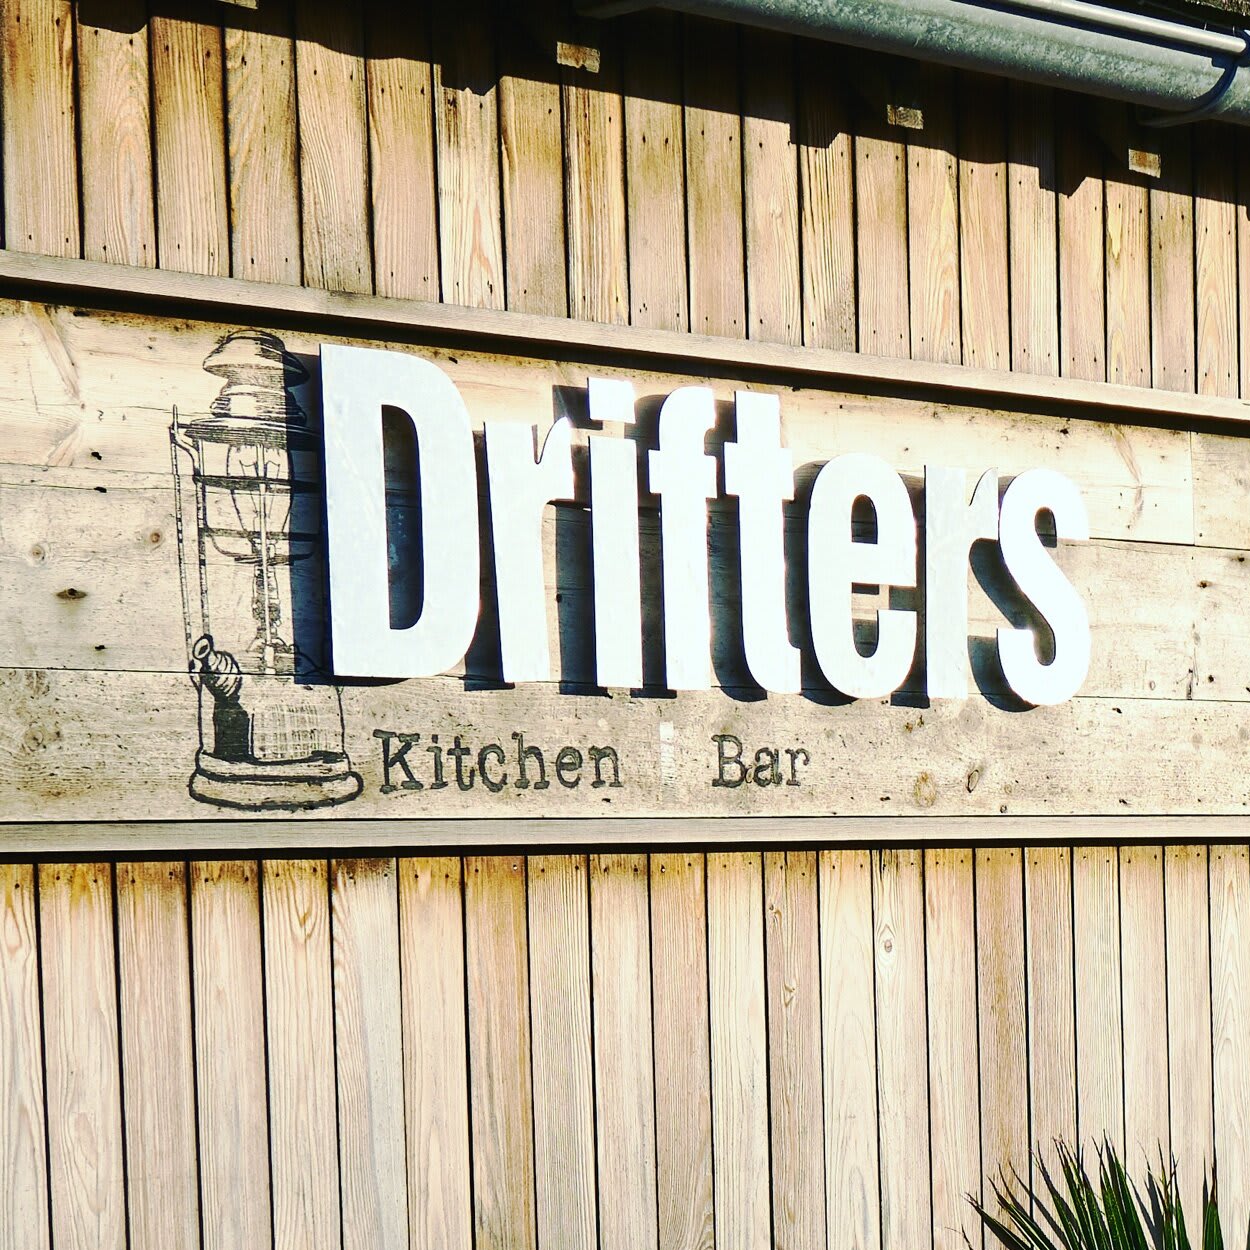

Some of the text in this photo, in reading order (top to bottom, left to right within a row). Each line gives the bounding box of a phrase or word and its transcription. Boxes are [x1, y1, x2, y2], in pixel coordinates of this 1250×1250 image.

[321, 344, 1091, 706] Drifters
[373, 729, 809, 794] Kitchen Bar
